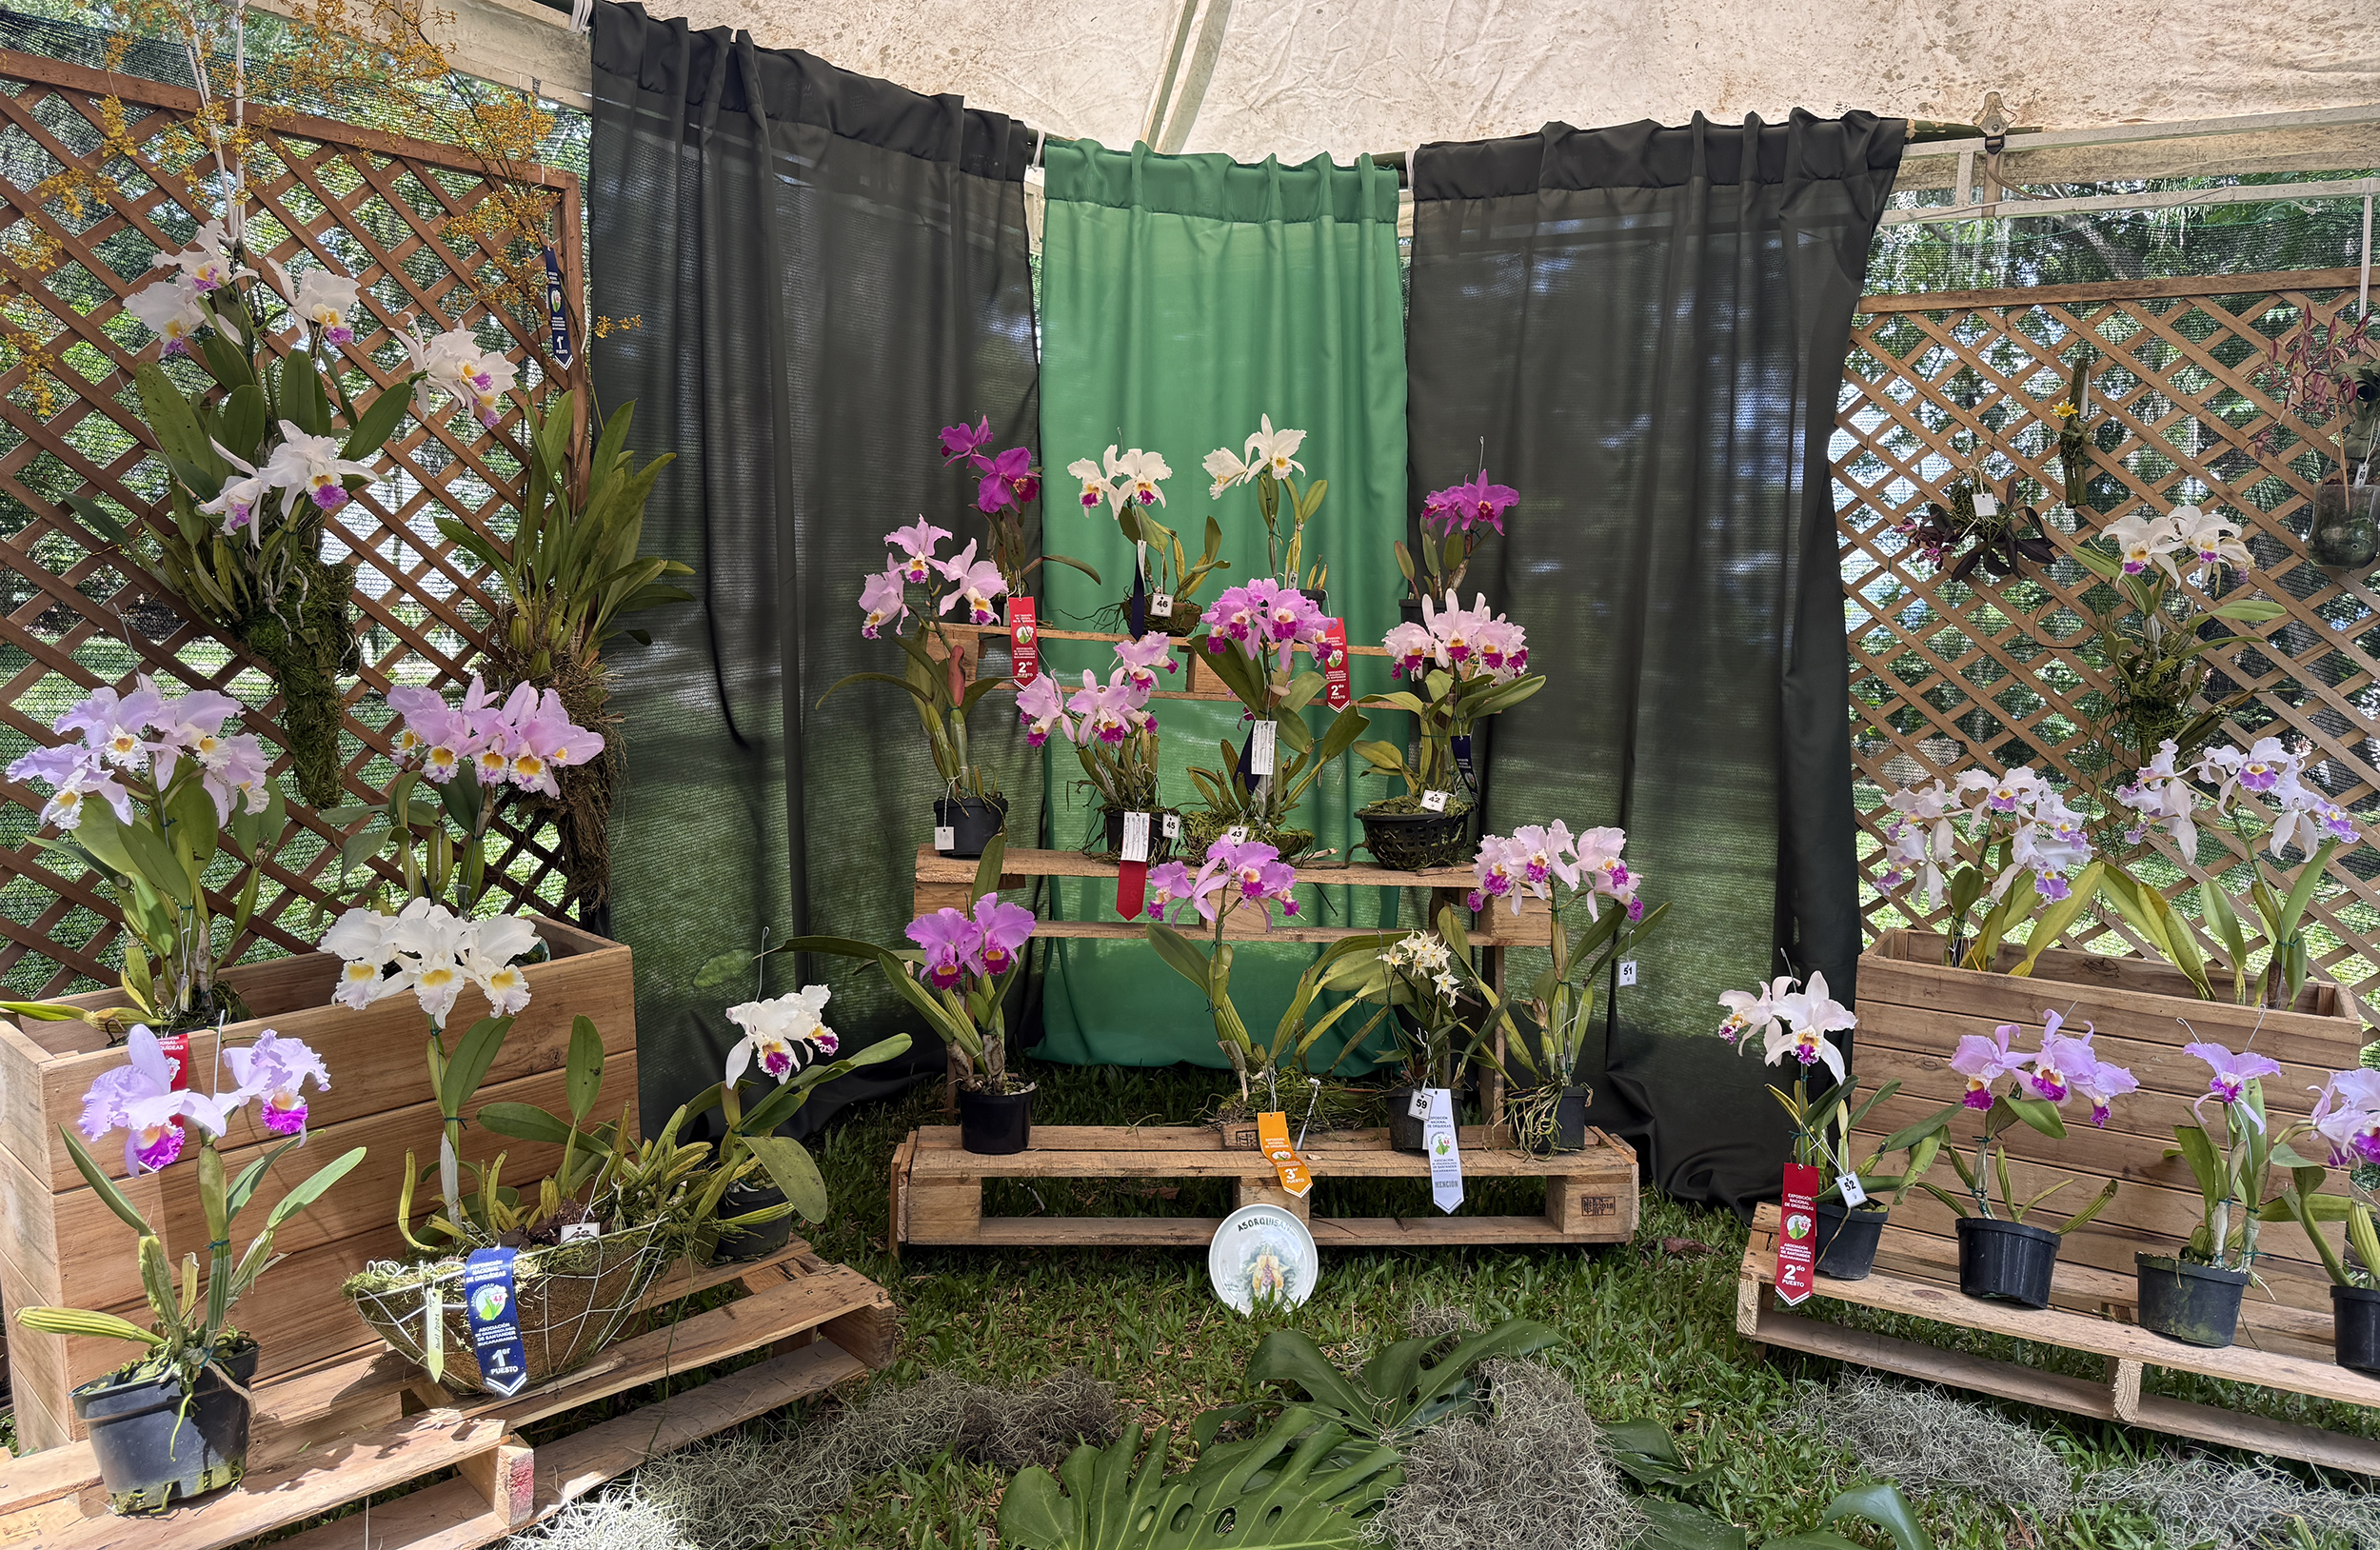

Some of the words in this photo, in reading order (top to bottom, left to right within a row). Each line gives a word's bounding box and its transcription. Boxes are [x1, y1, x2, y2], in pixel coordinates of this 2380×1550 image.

[1157, 600, 1168, 608] 46
[1166, 821, 1176, 829] 45
[1623, 966, 1633, 975] 51
[1416, 1098, 1428, 1109] 59
[1435, 1180, 1458, 1188] MENCIÓN
[1844, 1180, 1856, 1192] 52
[1237, 1217, 1292, 1232] ASORQUISAN
[471, 1266, 501, 1276] NACIONAL
[1783, 1263, 1806, 1281] 2do
[1782, 1279, 1805, 1287] PUESTO
[478, 1322, 510, 1333] ASOCIACIÓN
[486, 1330, 517, 1341] SANTANDER
[492, 1347, 511, 1367] 1er
[490, 1365, 519, 1375] PUESTO
